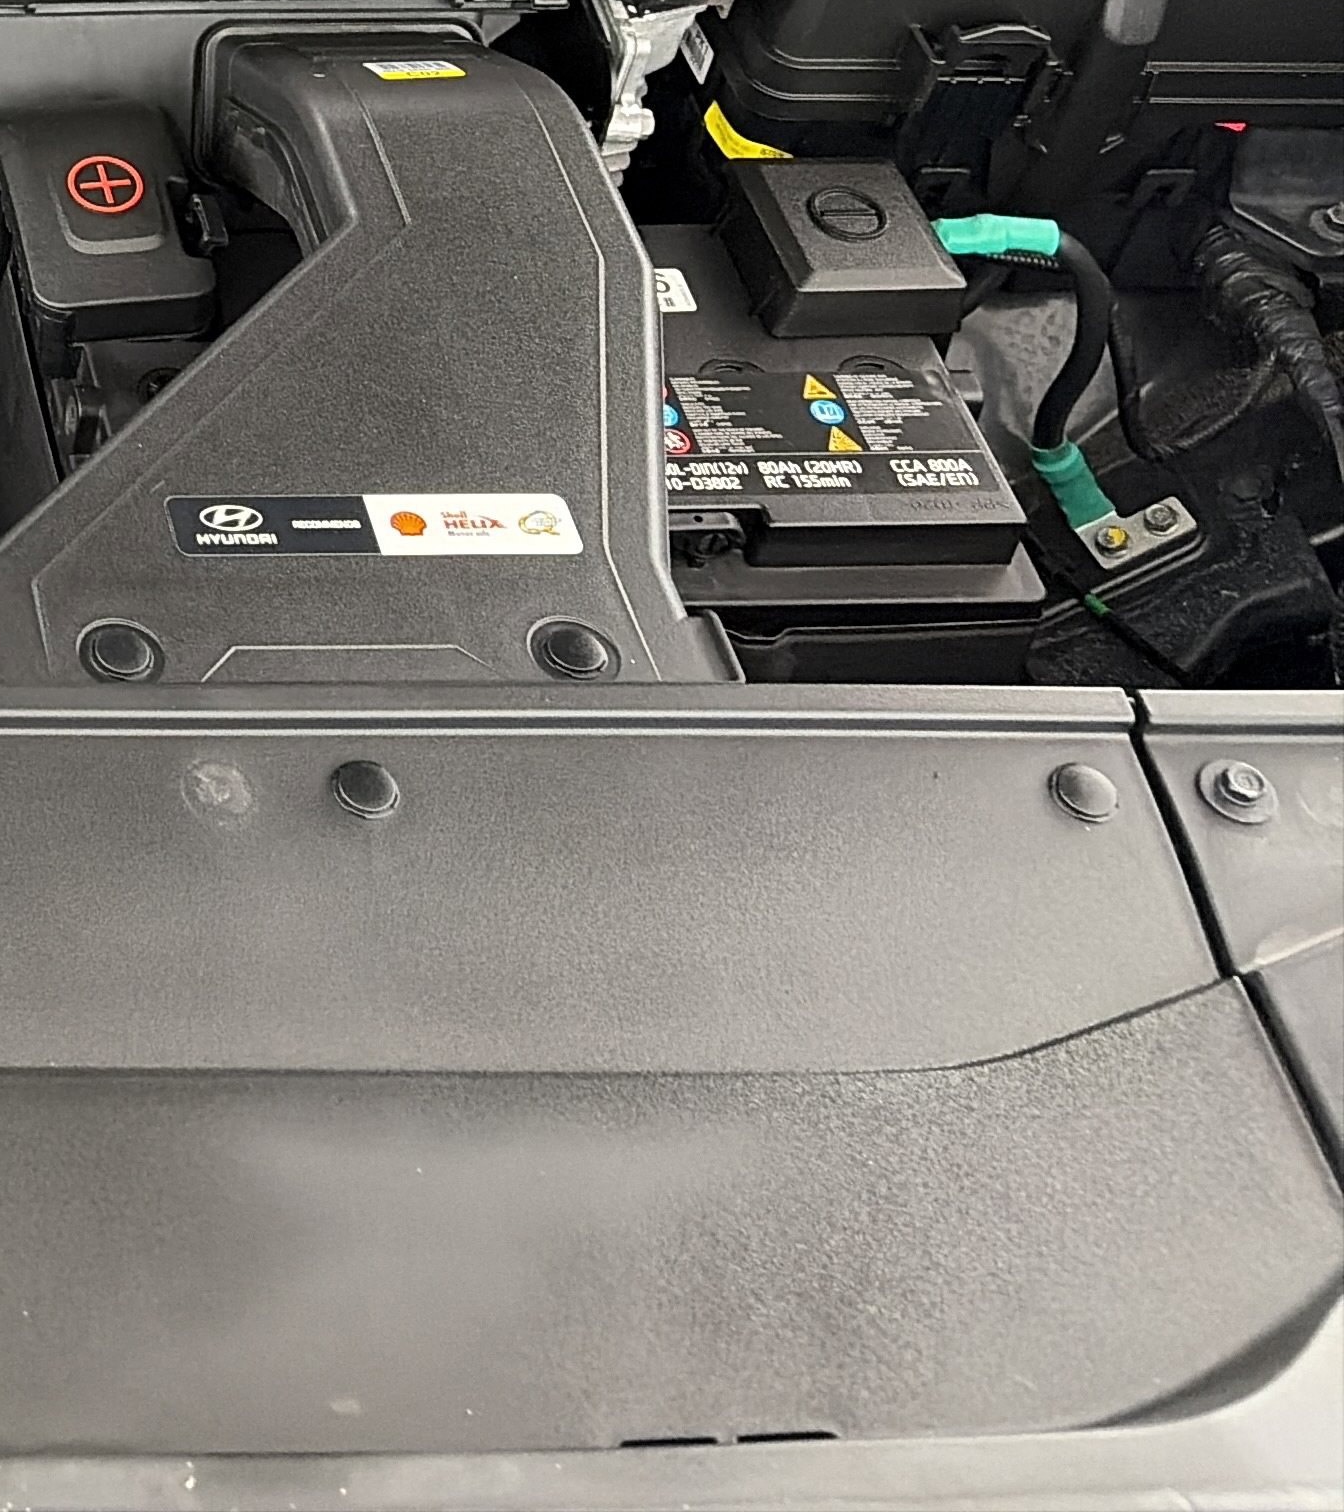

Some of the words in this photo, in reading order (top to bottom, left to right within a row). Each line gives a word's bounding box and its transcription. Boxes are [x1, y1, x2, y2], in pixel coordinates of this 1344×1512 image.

[756, 460, 803, 475] 80Ah
[803, 459, 863, 474] (20HR)
[889, 459, 928, 473] CCA
[927, 458, 974, 472] 800A
[762, 474, 791, 489] RC
[440, 510, 468, 519] Shell
[443, 517, 508, 530] HELIX
[197, 533, 278, 546] HYUNDAI
